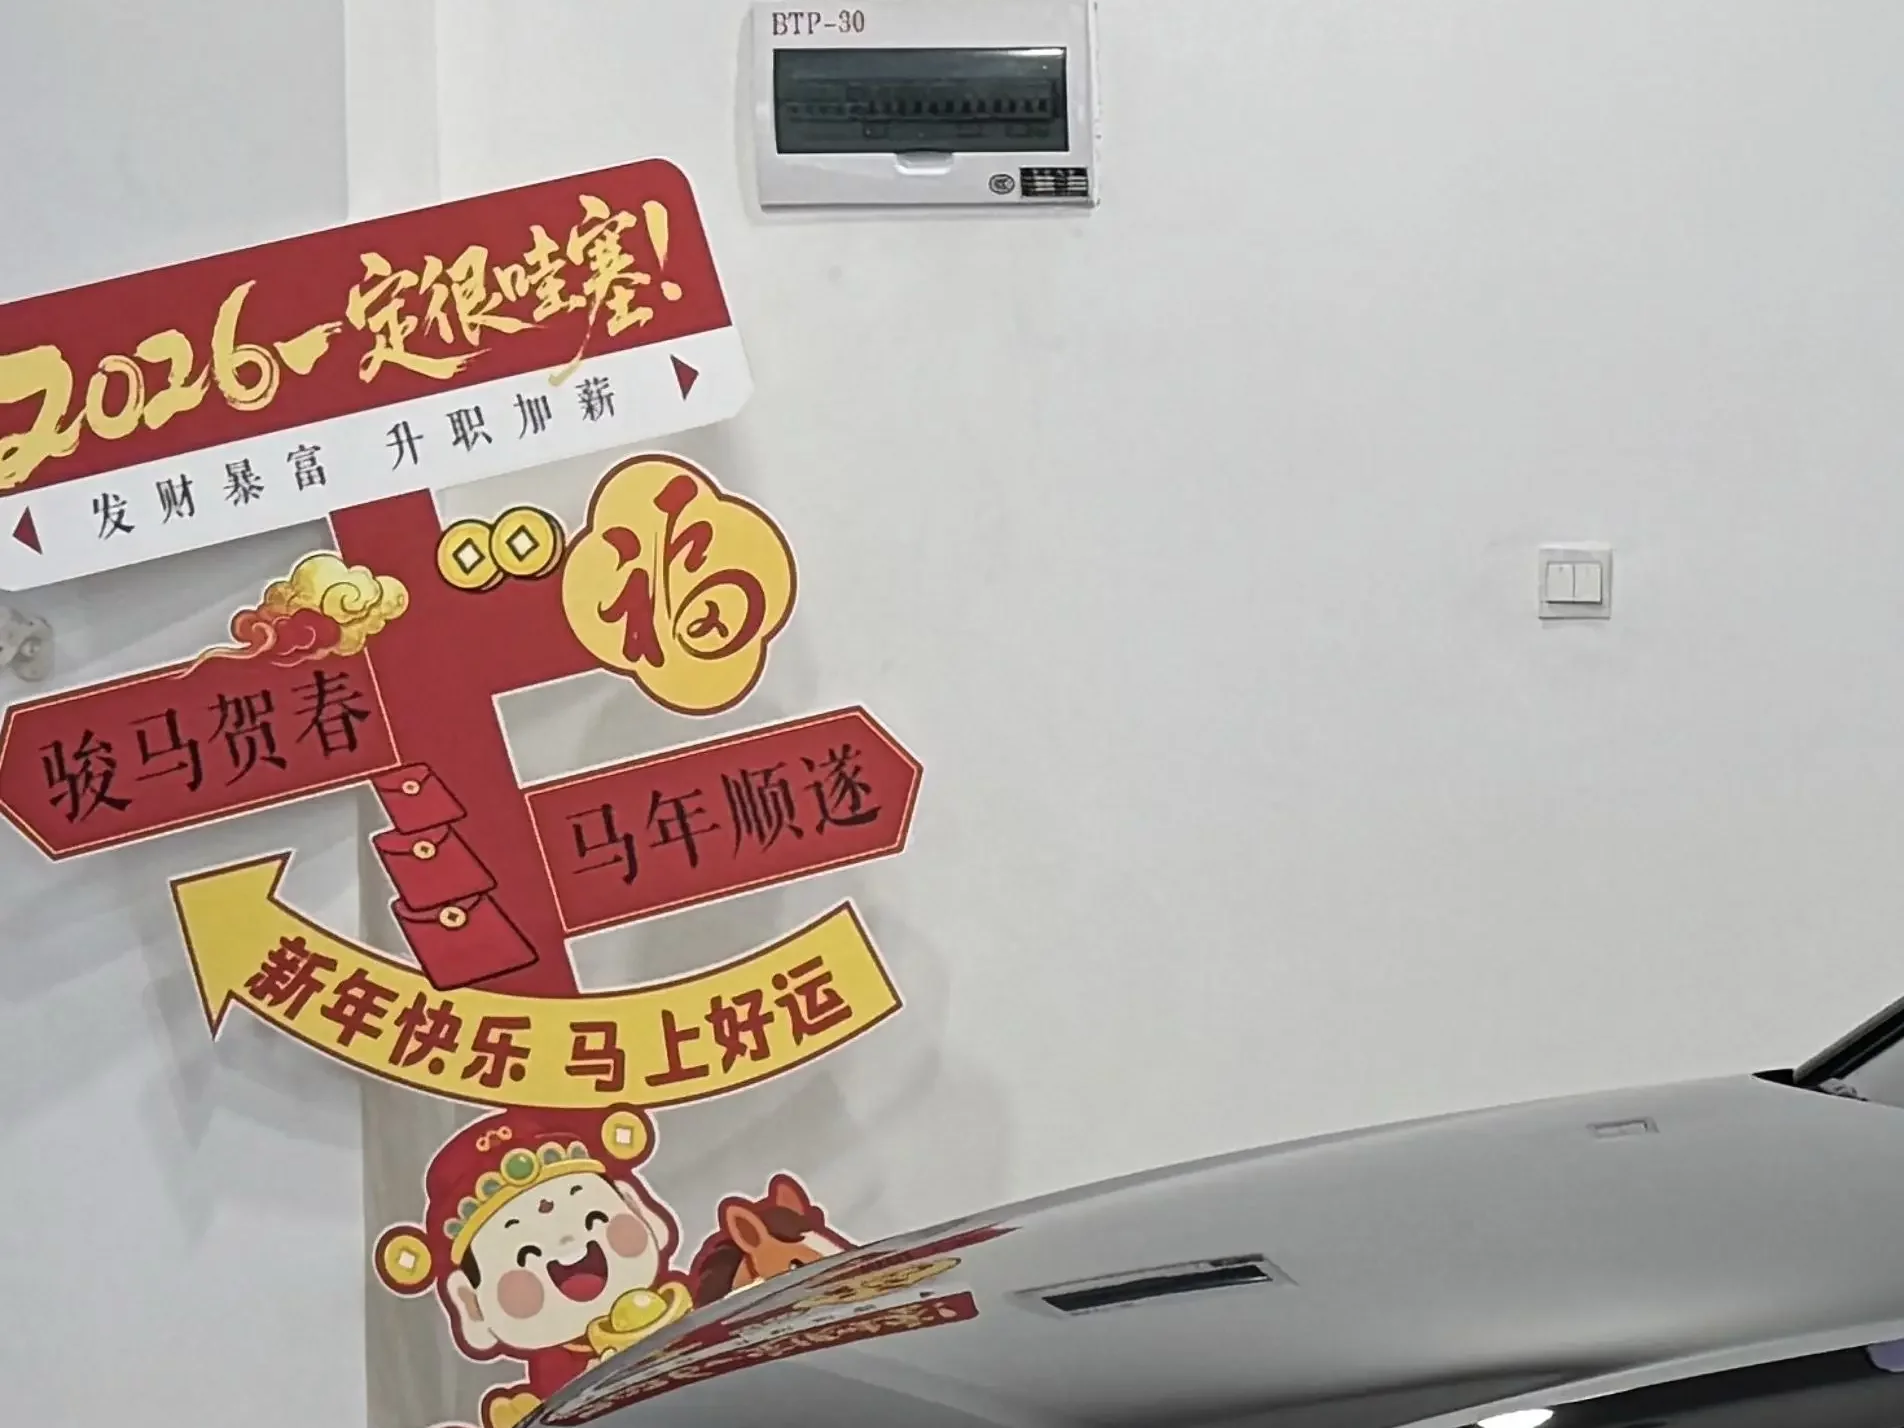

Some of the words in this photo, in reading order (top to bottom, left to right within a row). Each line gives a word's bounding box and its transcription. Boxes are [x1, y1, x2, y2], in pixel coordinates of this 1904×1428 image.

[770, 9, 866, 36] BTP-30
[91, 443, 327, 539] 发财暴富
[385, 375, 616, 470] 升职加薪
[600, 474, 765, 664] 福
[37, 667, 371, 826] 骏马贺春
[566, 741, 883, 888] 马年顺遂
[246, 936, 530, 1088] 新年快乐
[565, 954, 852, 1092] 马上好运
